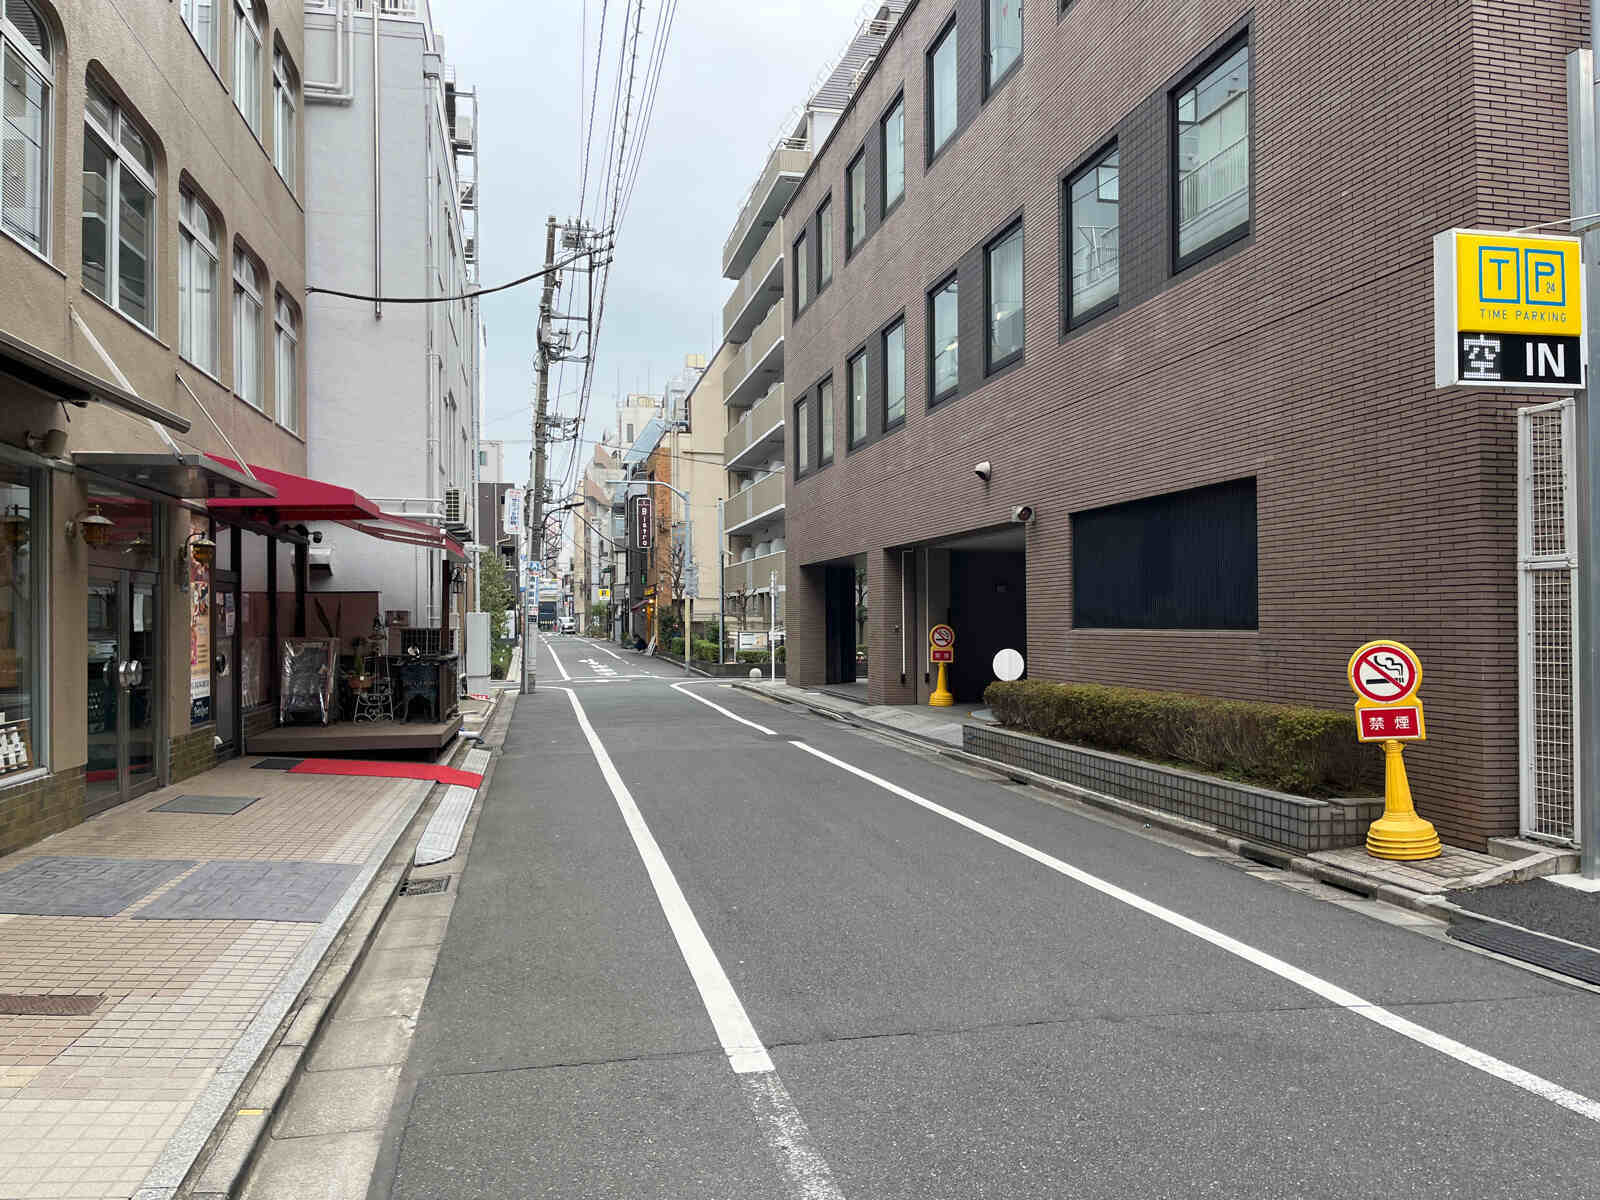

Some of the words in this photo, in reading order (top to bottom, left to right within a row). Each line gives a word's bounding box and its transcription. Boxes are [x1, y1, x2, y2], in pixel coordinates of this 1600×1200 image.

[1546, 281, 1556, 294] 24
[1480, 309, 1507, 321] TIME
[1515, 310, 1567, 323] PARKING
[1463, 334, 1501, 380] 空
[1526, 341, 1566, 378] IN
